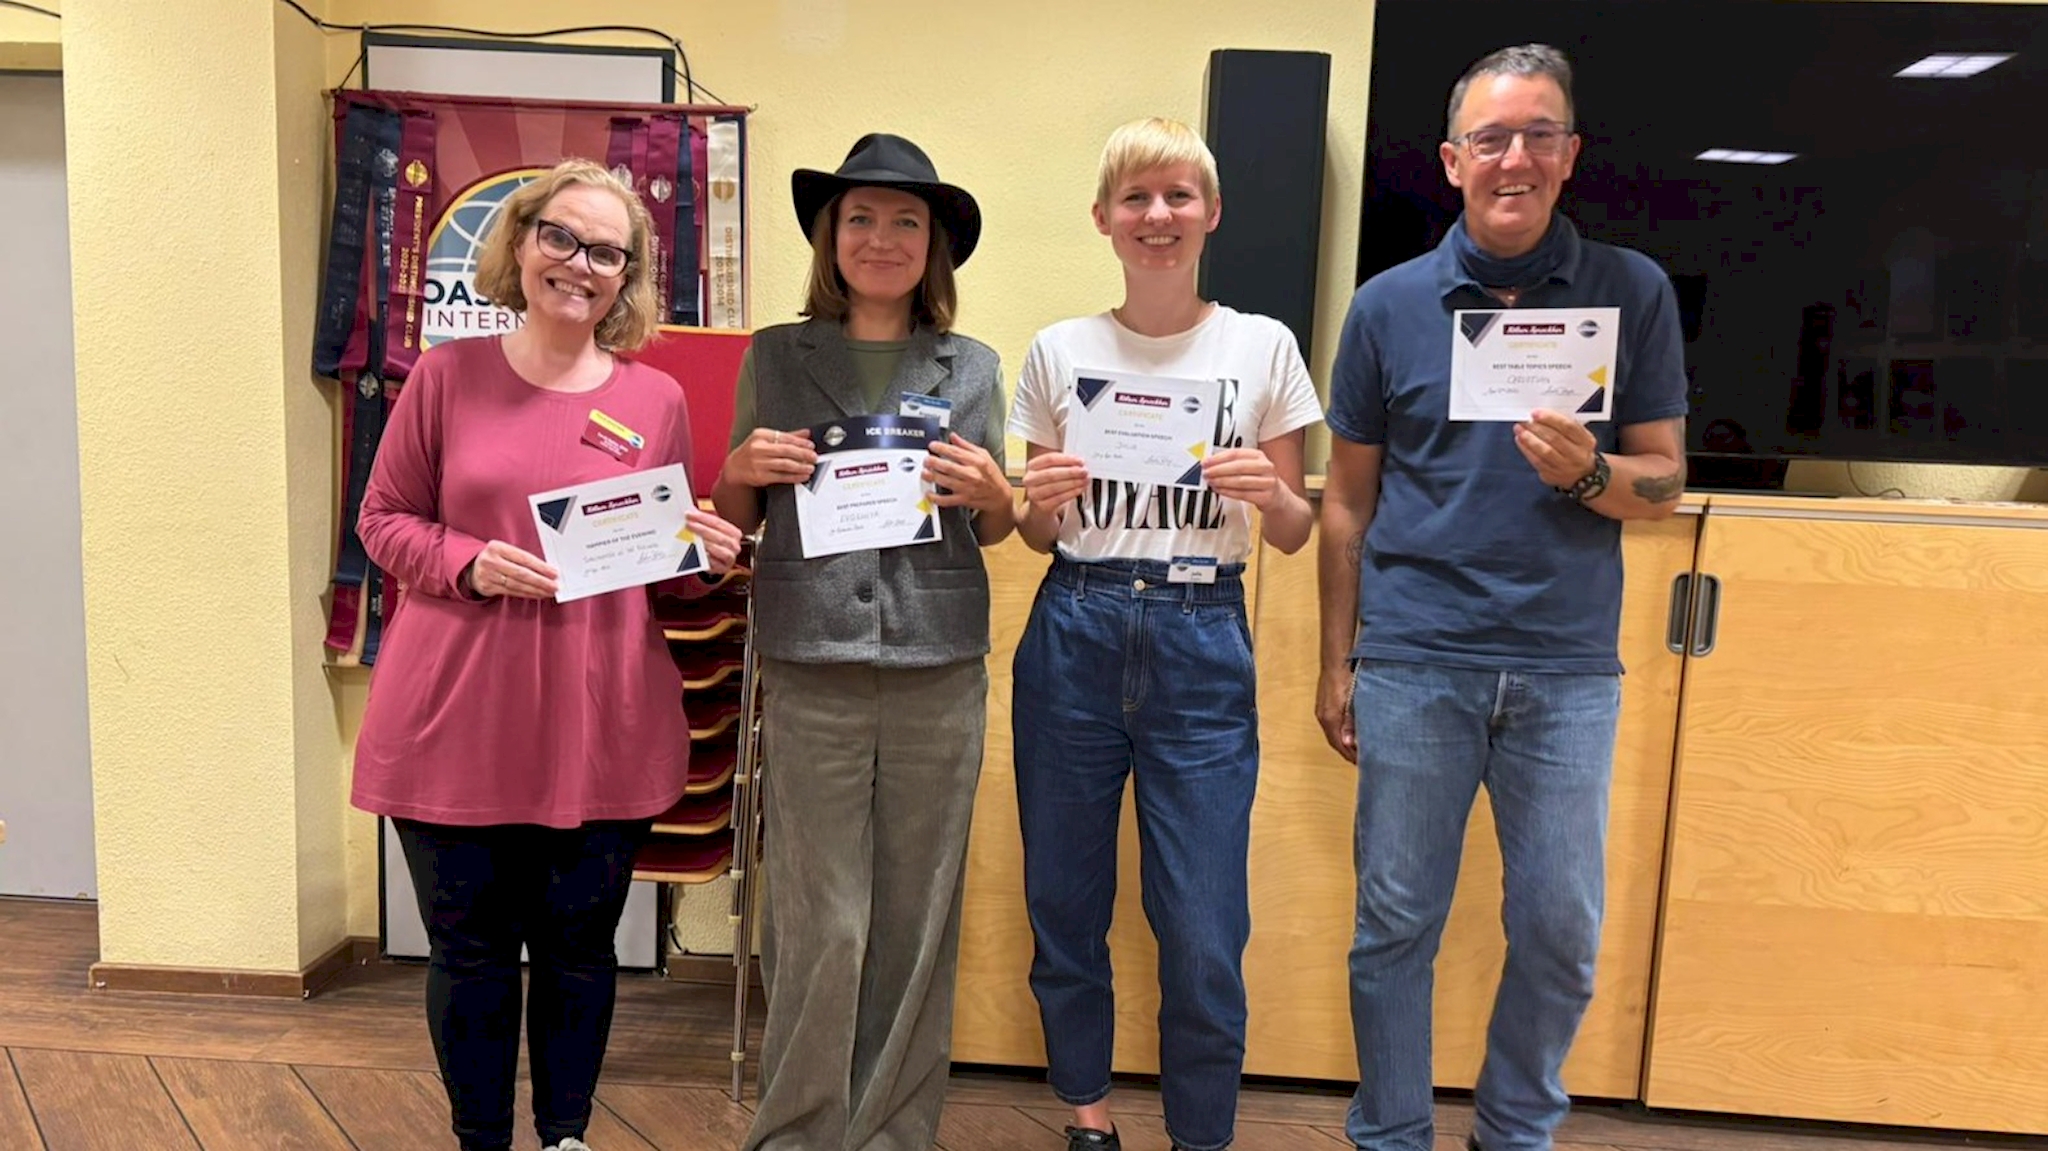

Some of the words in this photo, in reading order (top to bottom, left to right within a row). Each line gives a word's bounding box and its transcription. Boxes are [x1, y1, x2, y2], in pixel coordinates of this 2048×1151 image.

[727, 307, 736, 328] CLU
[404, 324, 414, 348] CLUB
[865, 427, 882, 436] ICE
[884, 427, 926, 439] BREAKER
